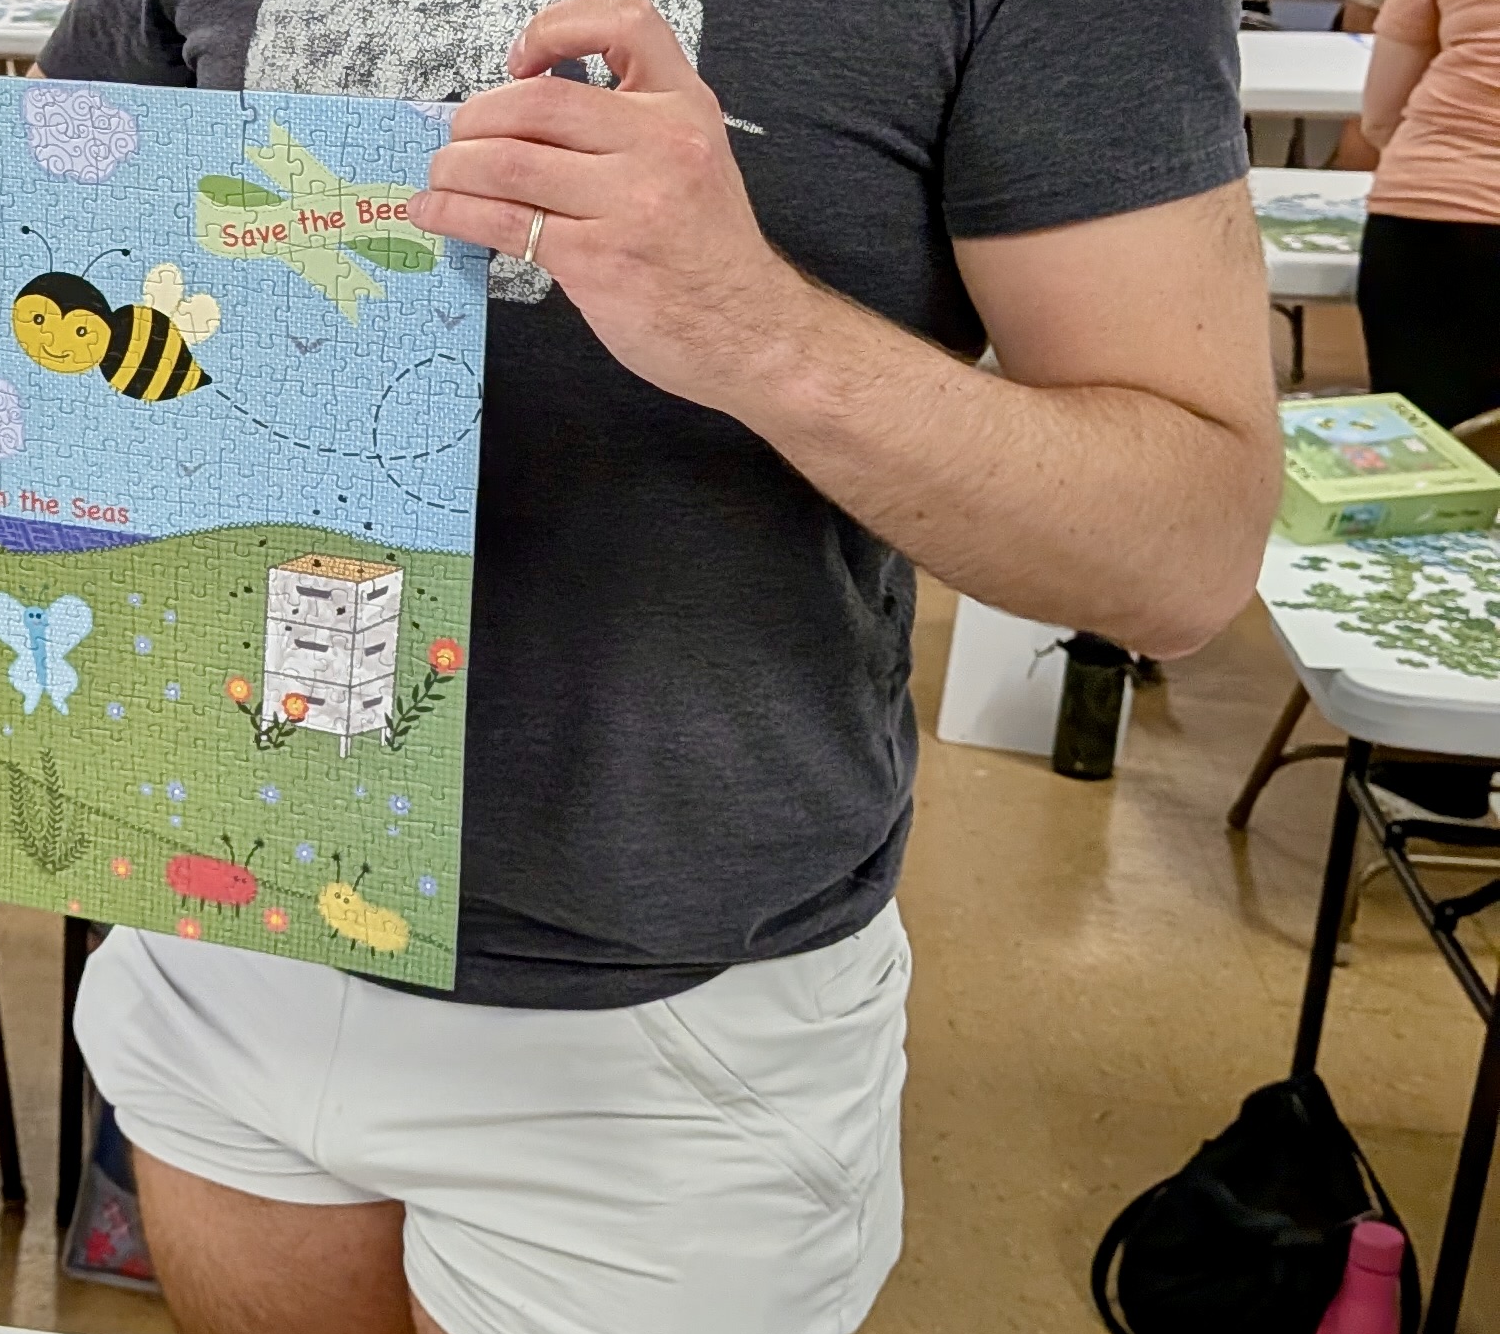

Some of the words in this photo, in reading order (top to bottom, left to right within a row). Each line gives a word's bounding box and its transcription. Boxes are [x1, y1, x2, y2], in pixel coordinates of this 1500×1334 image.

[222, 223, 288, 247] Save
[297, 209, 346, 234] the
[356, 199, 409, 224] Bee
[19, 489, 60, 515] the
[71, 497, 130, 524] Seas
